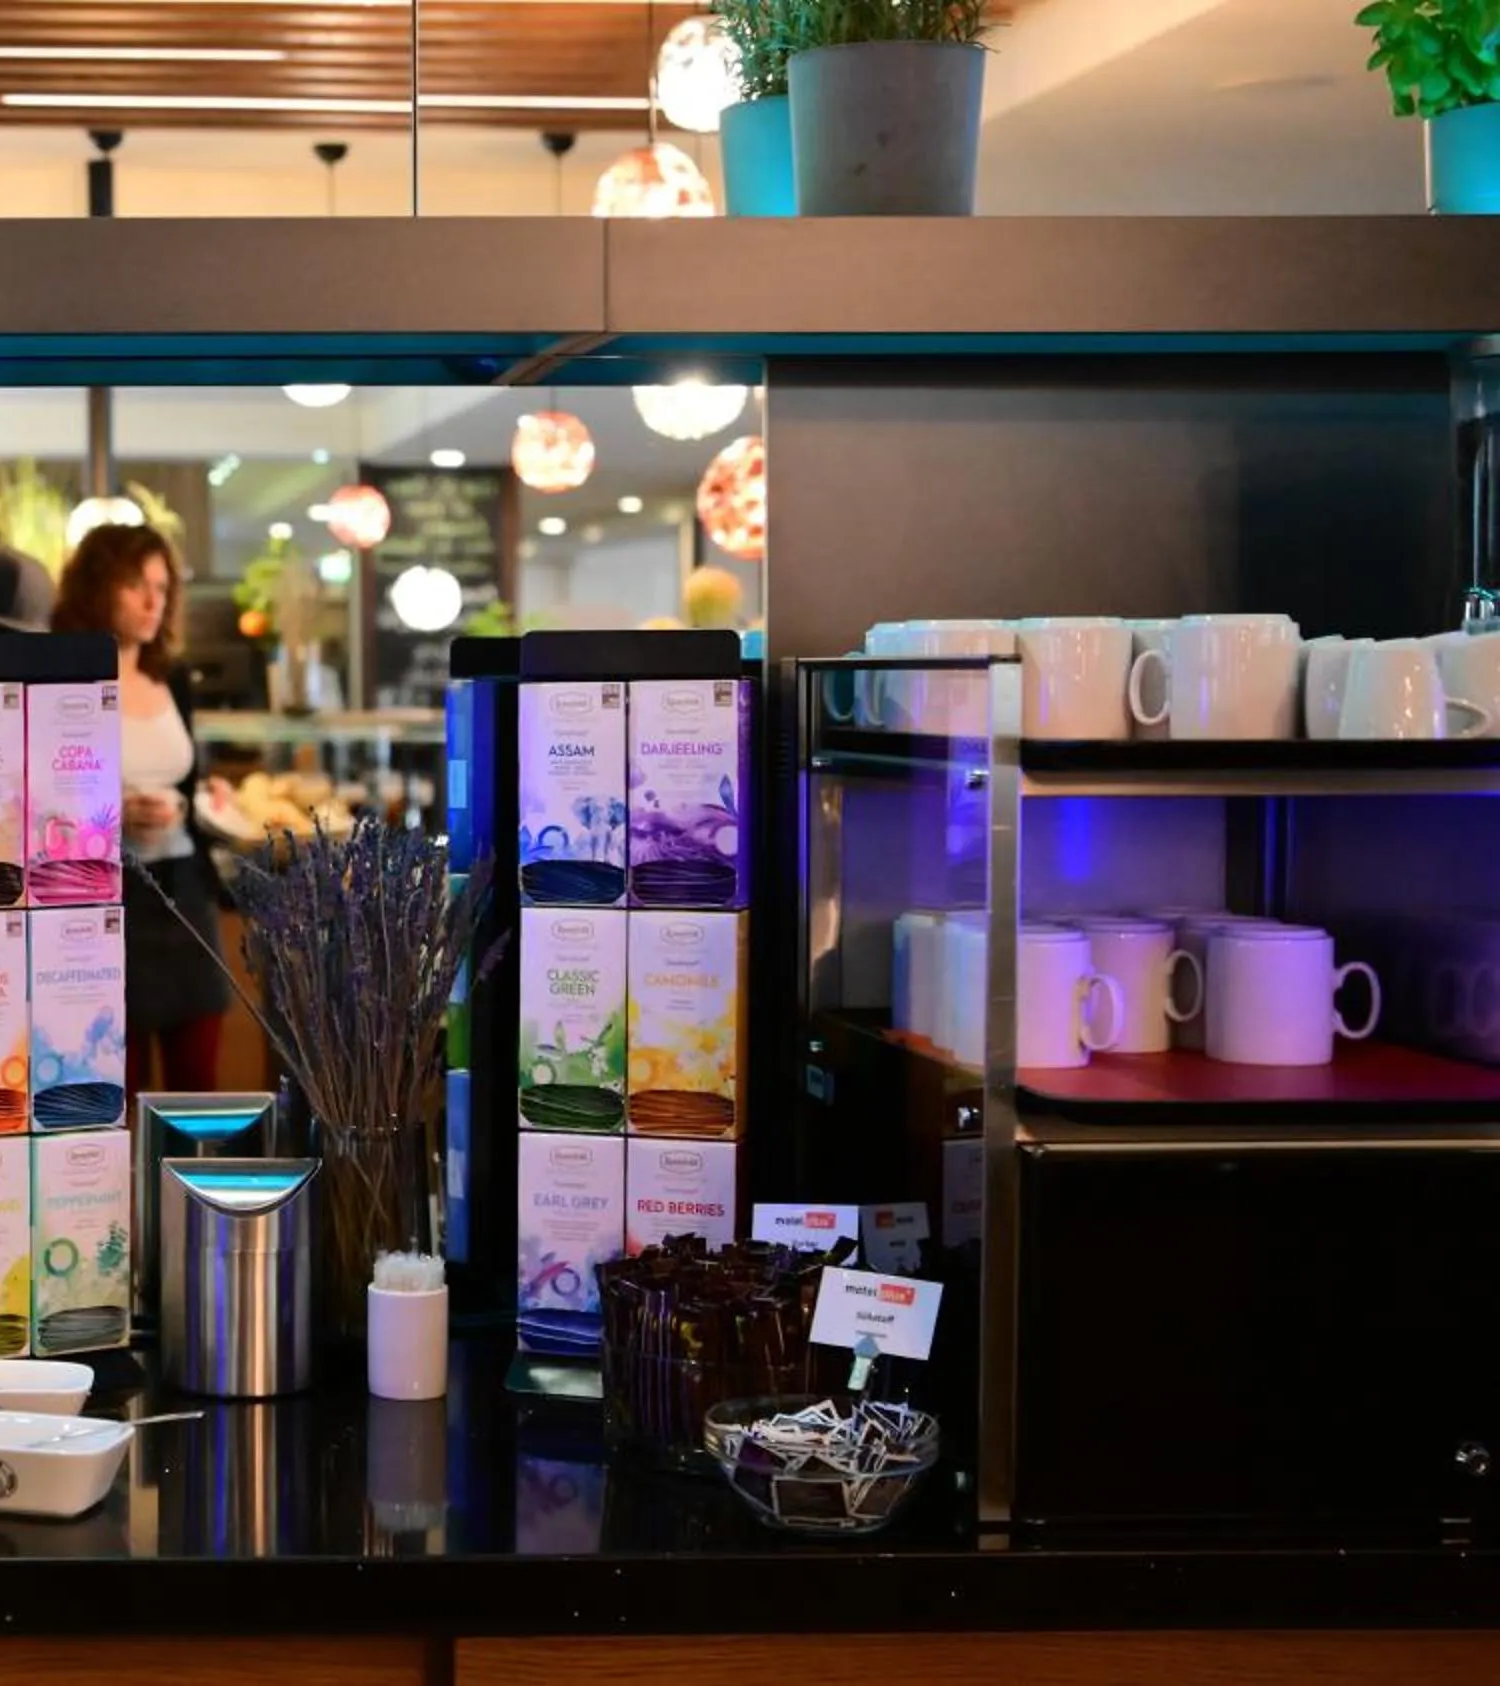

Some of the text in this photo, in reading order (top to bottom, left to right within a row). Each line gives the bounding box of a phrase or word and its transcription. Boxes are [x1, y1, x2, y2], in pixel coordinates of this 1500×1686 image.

[58, 746, 93, 758] COPA
[548, 745, 595, 757] ASSAM
[641, 742, 723, 756] DARJEELING
[546, 969, 600, 983] CLASSIC
[549, 983, 596, 996] GREEN
[533, 1192, 609, 1211] EARL GREY
[637, 1199, 726, 1217] RED BERRIES
